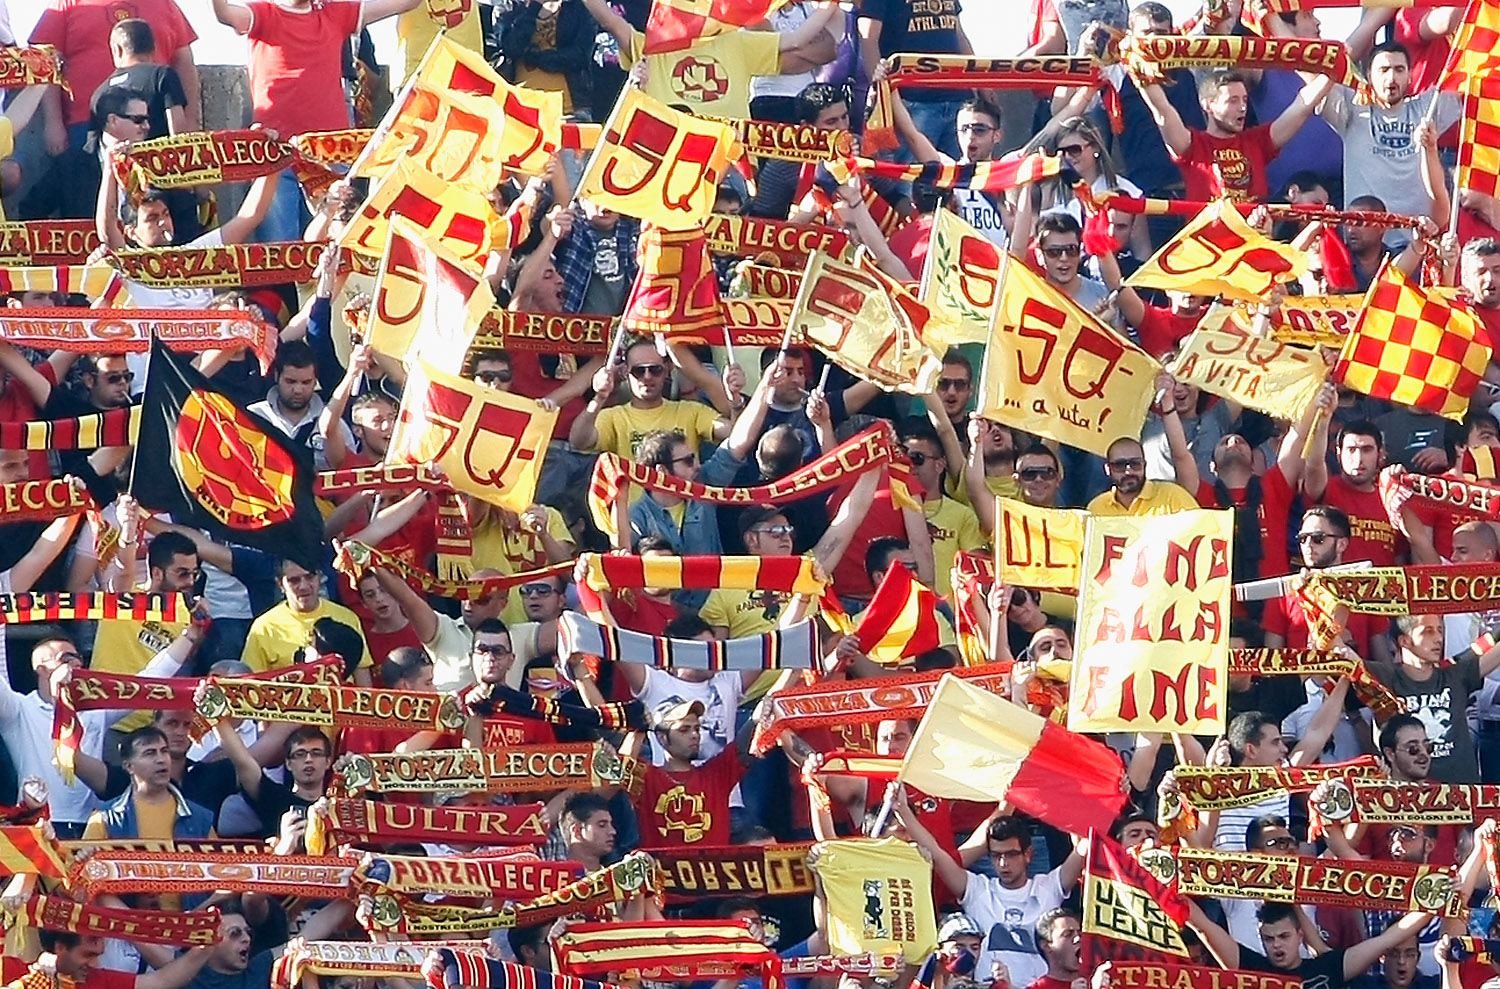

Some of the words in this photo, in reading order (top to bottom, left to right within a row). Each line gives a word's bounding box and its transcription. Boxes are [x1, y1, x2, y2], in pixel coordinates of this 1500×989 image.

[964, 59, 1092, 75] LECCE
[1244, 41, 1339, 69] LECCE
[33, 226, 98, 261] LECC
[744, 221, 835, 254] LECCE
[126, 249, 238, 283] FORZA
[244, 243, 325, 273] LECC
[509, 311, 605, 343] LECCE
[321, 463, 444, 491] LECC
[1098, 599, 1222, 645] ALLA
[227, 681, 333, 716] FORZA
[337, 690, 436, 726] LECCE
[1080, 664, 1219, 727] FINE
[379, 757, 484, 784] FORZA
[489, 752, 587, 781] LECCE
[1177, 773, 1278, 802] FORZA
[1360, 784, 1471, 812] FORZA
[1182, 858, 1296, 889] FORZA
[1301, 866, 1409, 901] LECCE
